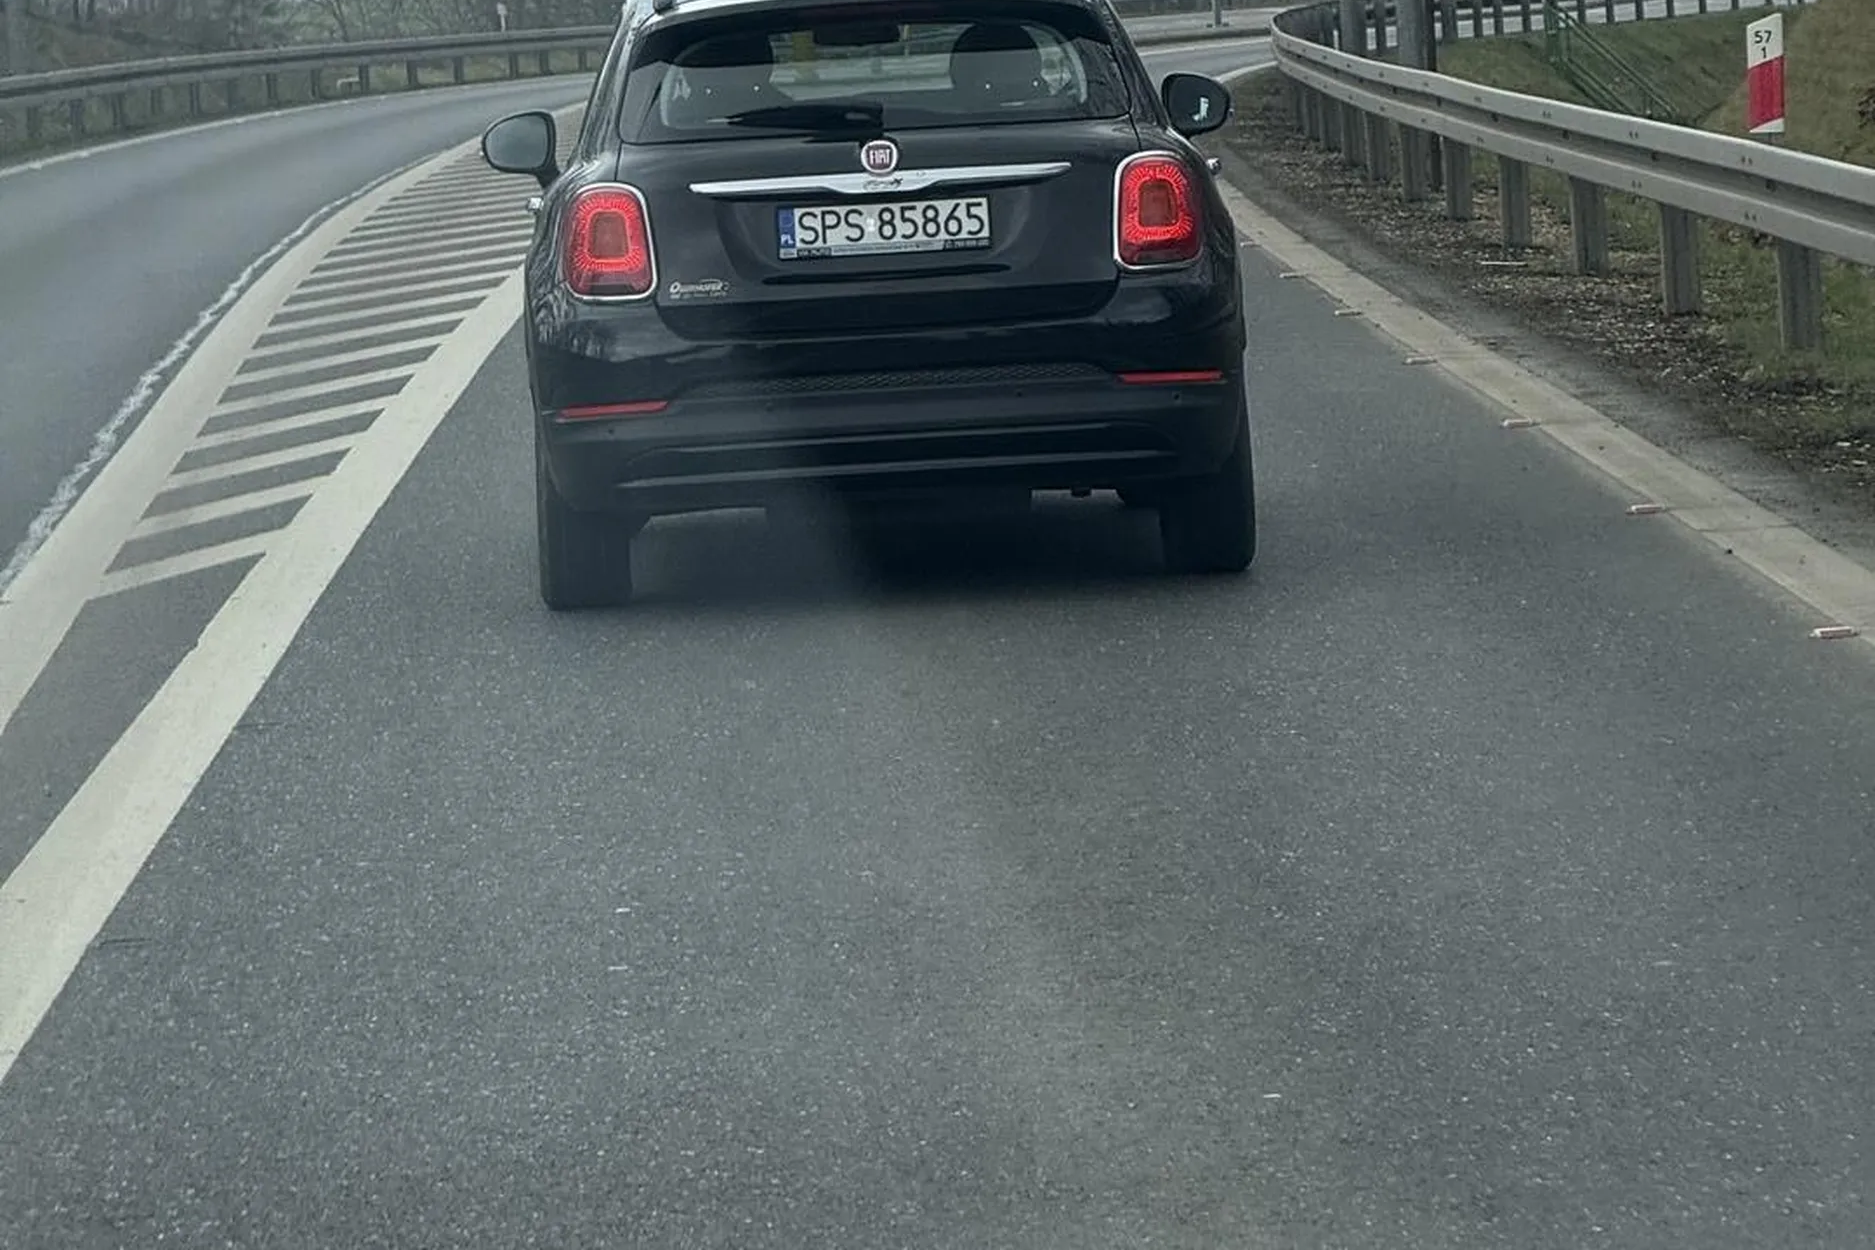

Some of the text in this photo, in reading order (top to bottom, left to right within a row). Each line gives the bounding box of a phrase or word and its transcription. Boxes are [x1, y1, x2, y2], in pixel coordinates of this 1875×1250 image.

[1754, 30, 1772, 44] 57
[1761, 46, 1767, 59] 1
[870, 149, 890, 164] FIAT
[799, 202, 985, 245] SPS 85865
[780, 234, 794, 245] PL
